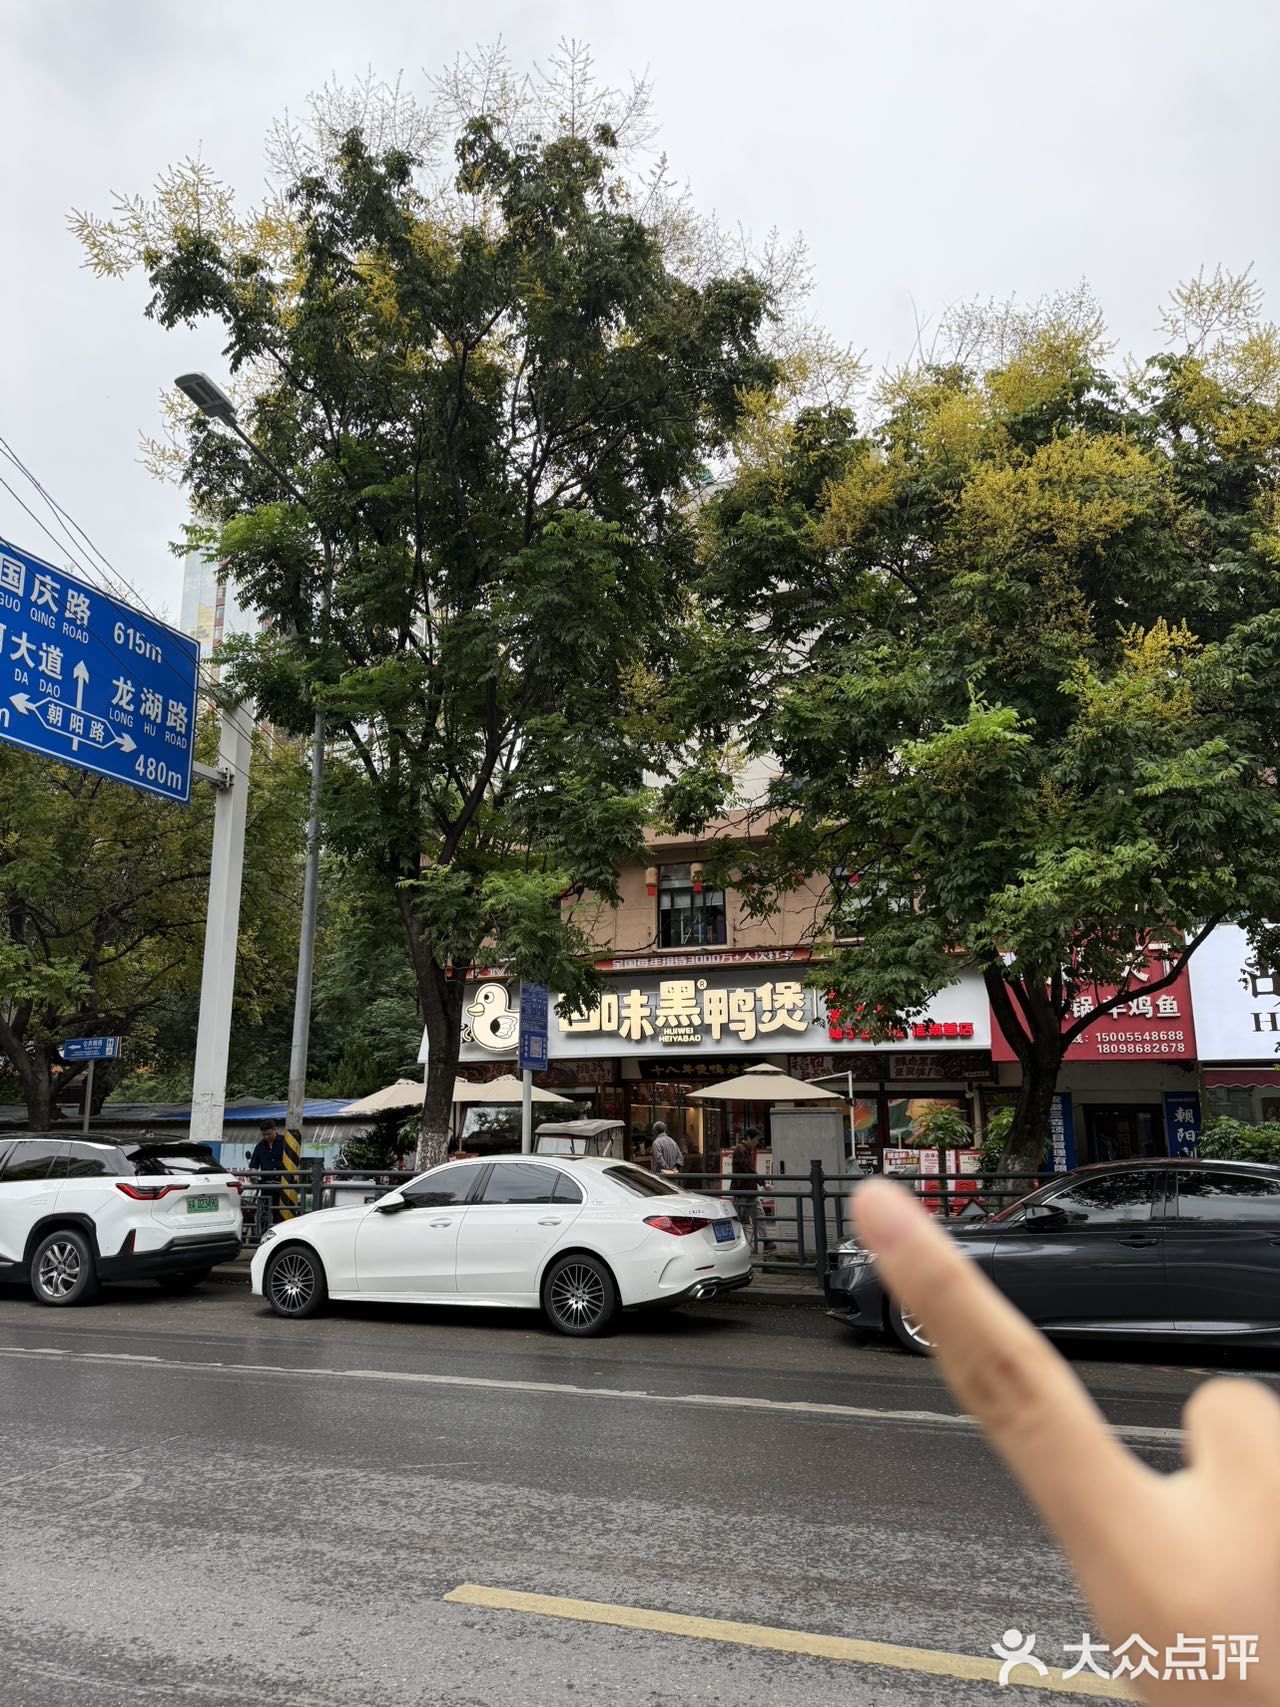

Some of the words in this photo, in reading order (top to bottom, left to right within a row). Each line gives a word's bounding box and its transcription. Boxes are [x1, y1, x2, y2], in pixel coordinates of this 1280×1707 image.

[0, 552, 91, 628] 国庆路
[0, 592, 20, 612] GUO
[30, 607, 56, 629] QING
[62, 622, 89, 644] ROAD
[113, 622, 162, 664] 615m
[14, 668, 28, 685] DA
[39, 679, 60, 698] DAO
[47, 703, 104, 742] 朝阳路
[111, 675, 188, 734] 龙湖路
[109, 708, 133, 728] LONG
[144, 723, 156, 737] HU
[165, 729, 187, 749] ROAD
[135, 754, 182, 790] 480m
[659, 1034, 702, 1043] HEIYABAO
[663, 1027, 694, 1035] HUIWEI
[1096, 1031, 1184, 1042] 15005548688
[1097, 1043, 1185, 1054] 18098682678
